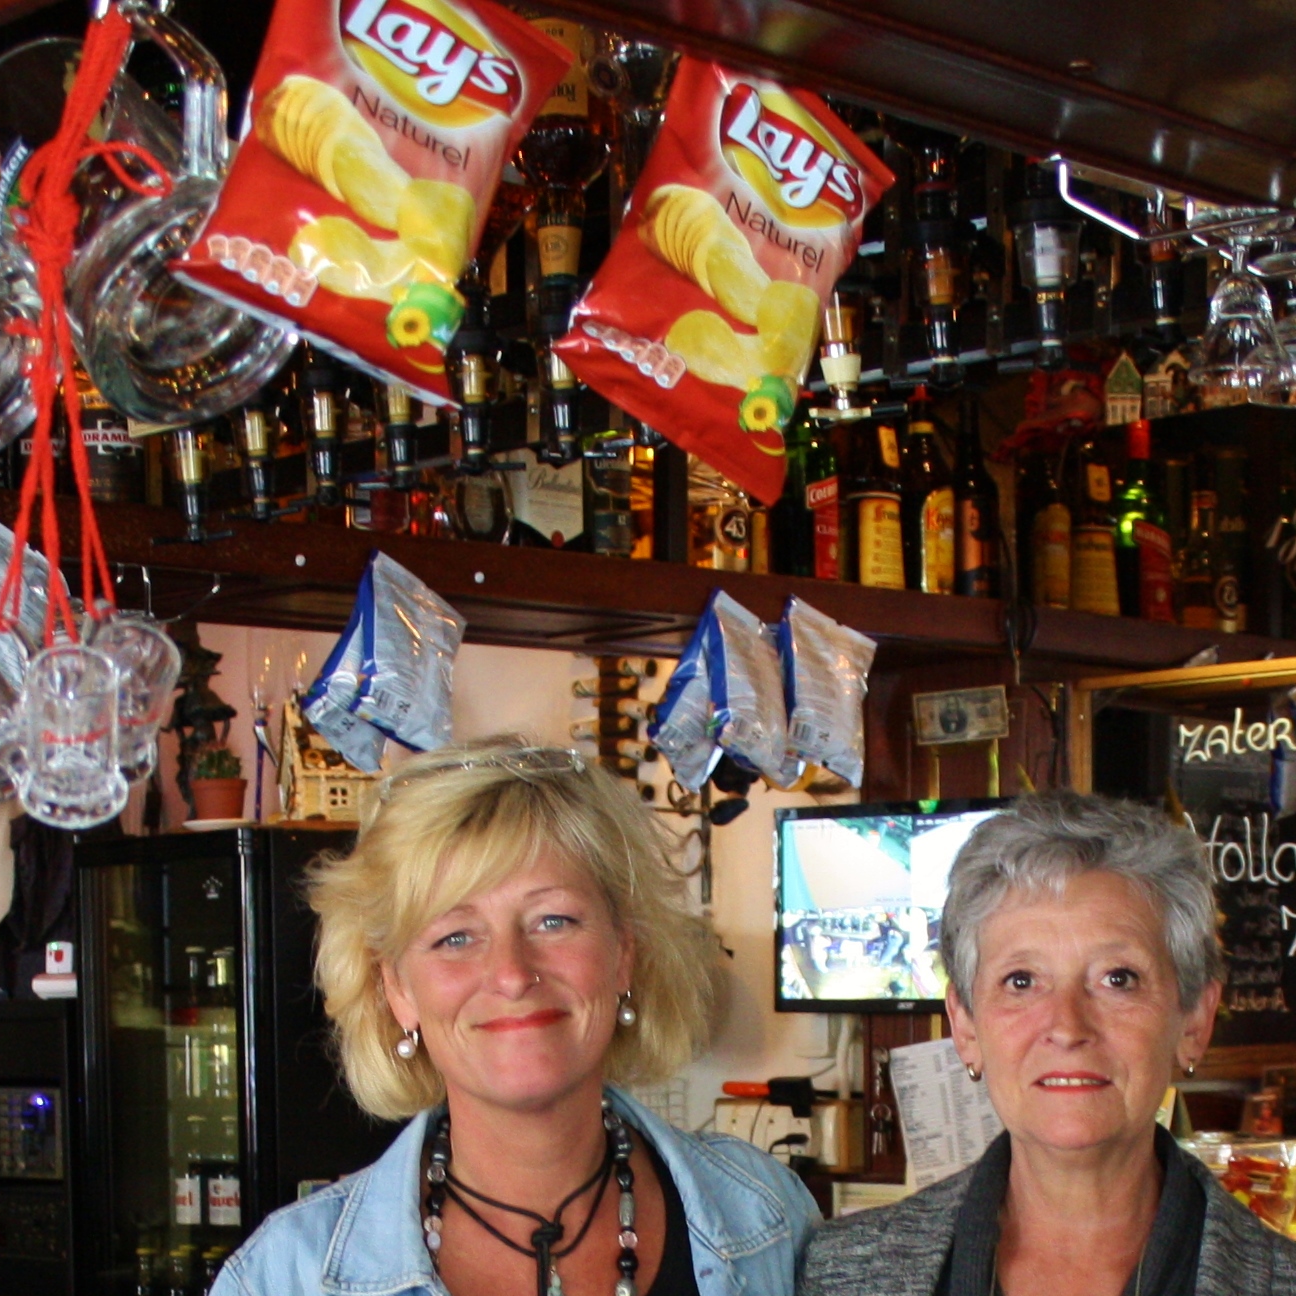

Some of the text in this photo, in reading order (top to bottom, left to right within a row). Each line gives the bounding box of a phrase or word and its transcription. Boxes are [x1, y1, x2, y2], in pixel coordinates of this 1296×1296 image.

[346, 0, 514, 106] Lay's
[353, 86, 471, 172] Naturel
[726, 89, 858, 208] Lay's
[725, 192, 825, 274] Naturel
[82, 431, 142, 445] DRAMB
[723, 516, 746, 538] 43
